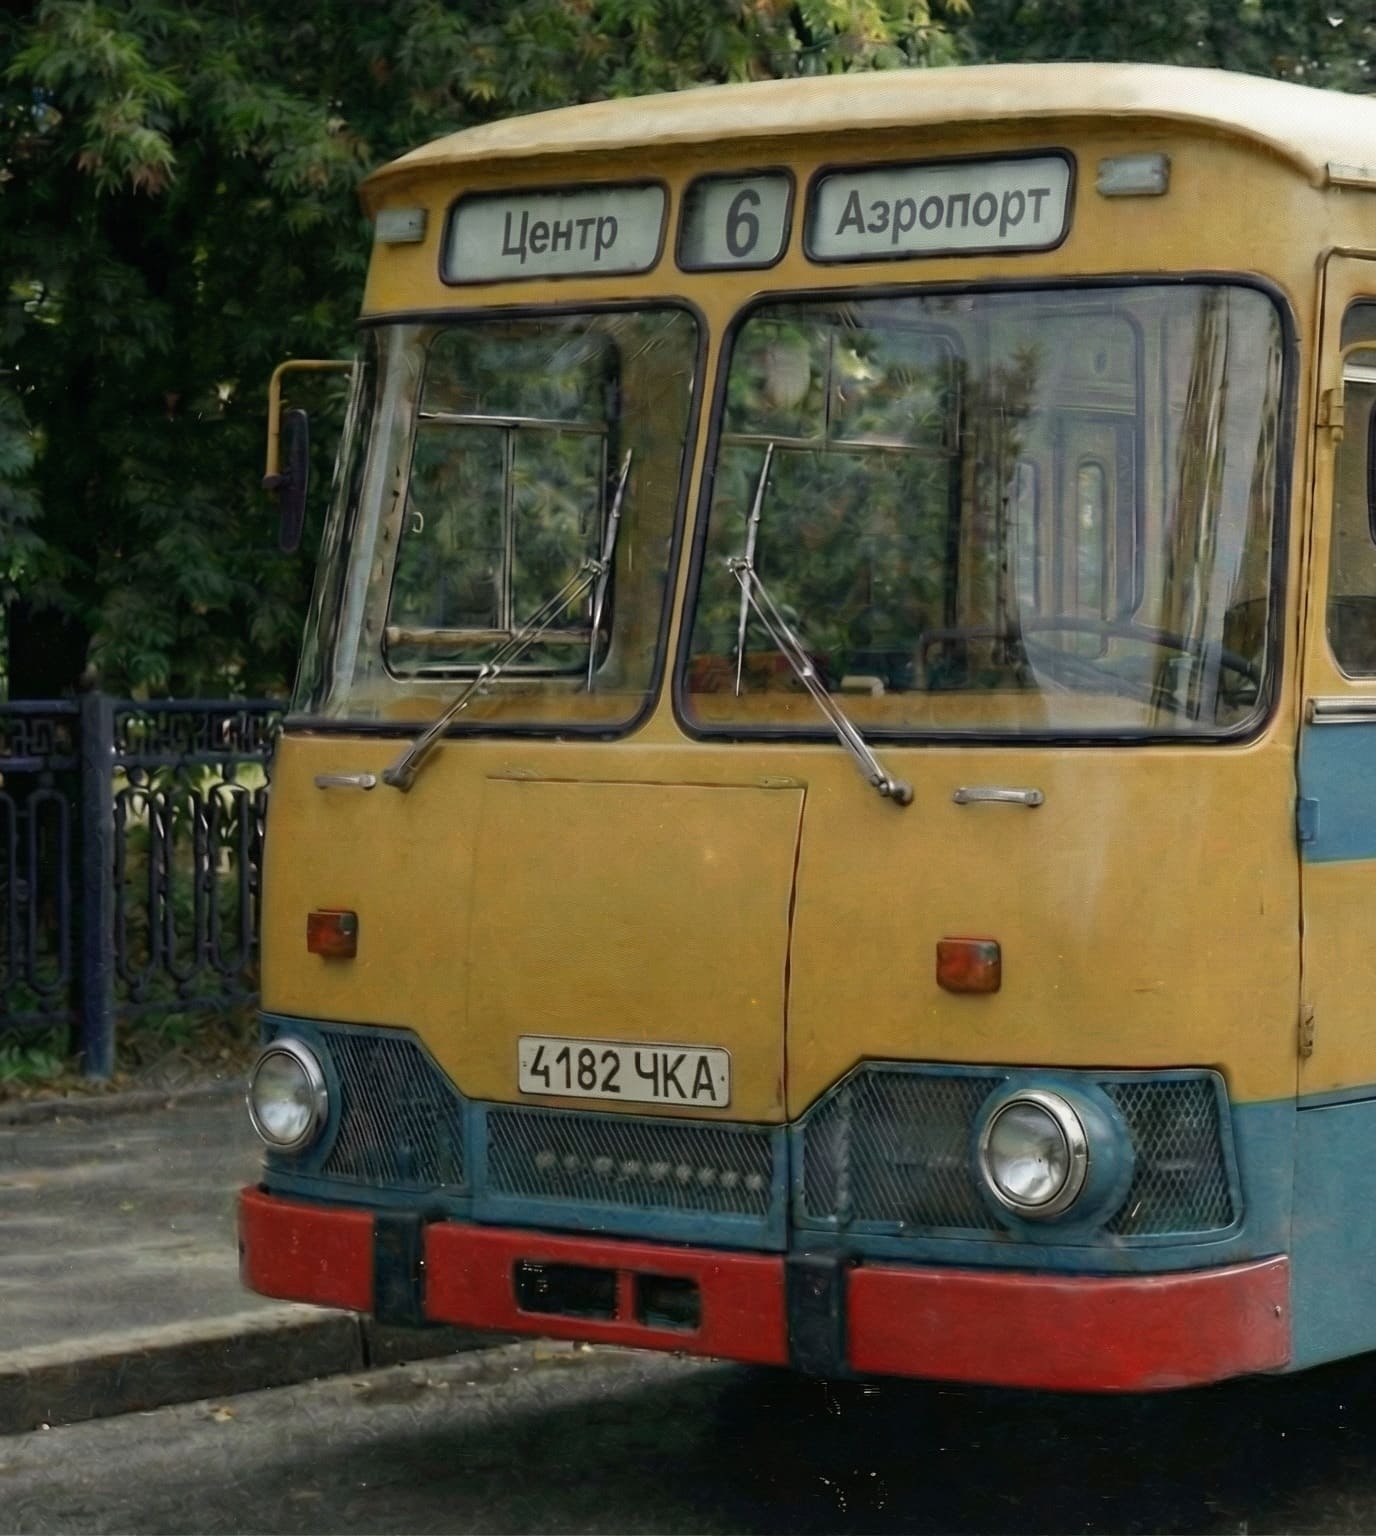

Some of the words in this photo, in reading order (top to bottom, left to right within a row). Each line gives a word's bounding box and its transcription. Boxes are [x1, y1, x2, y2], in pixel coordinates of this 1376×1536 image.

[501, 210, 618, 265] Центр
[725, 188, 761, 258] 6
[530, 1045, 621, 1093] 4182
[634, 1051, 717, 1101] ЧКА
